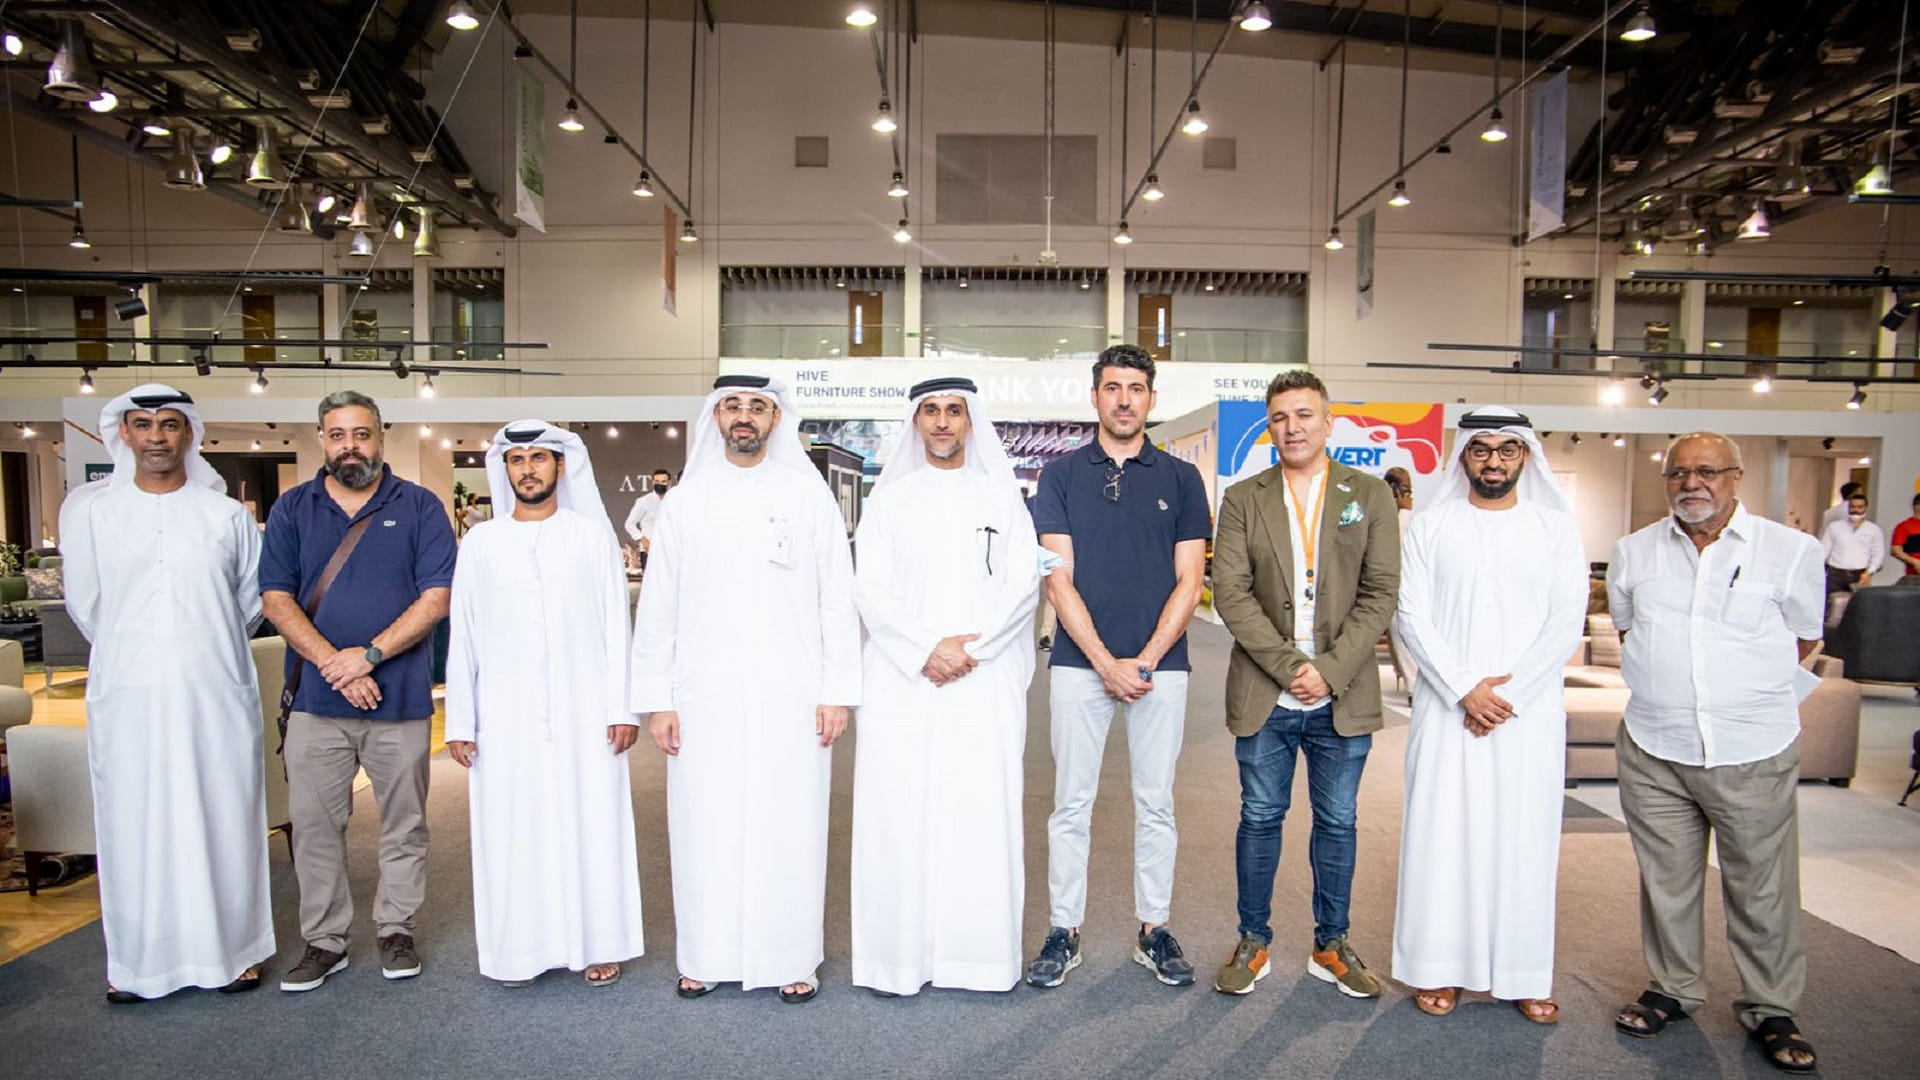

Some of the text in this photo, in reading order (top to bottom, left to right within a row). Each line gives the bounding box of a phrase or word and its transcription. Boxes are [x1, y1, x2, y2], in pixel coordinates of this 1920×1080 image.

[796, 371, 829, 381] HIVE
[1214, 379, 1268, 389] SEE YOU
[796, 387, 906, 397] FURNITURE SHOW
